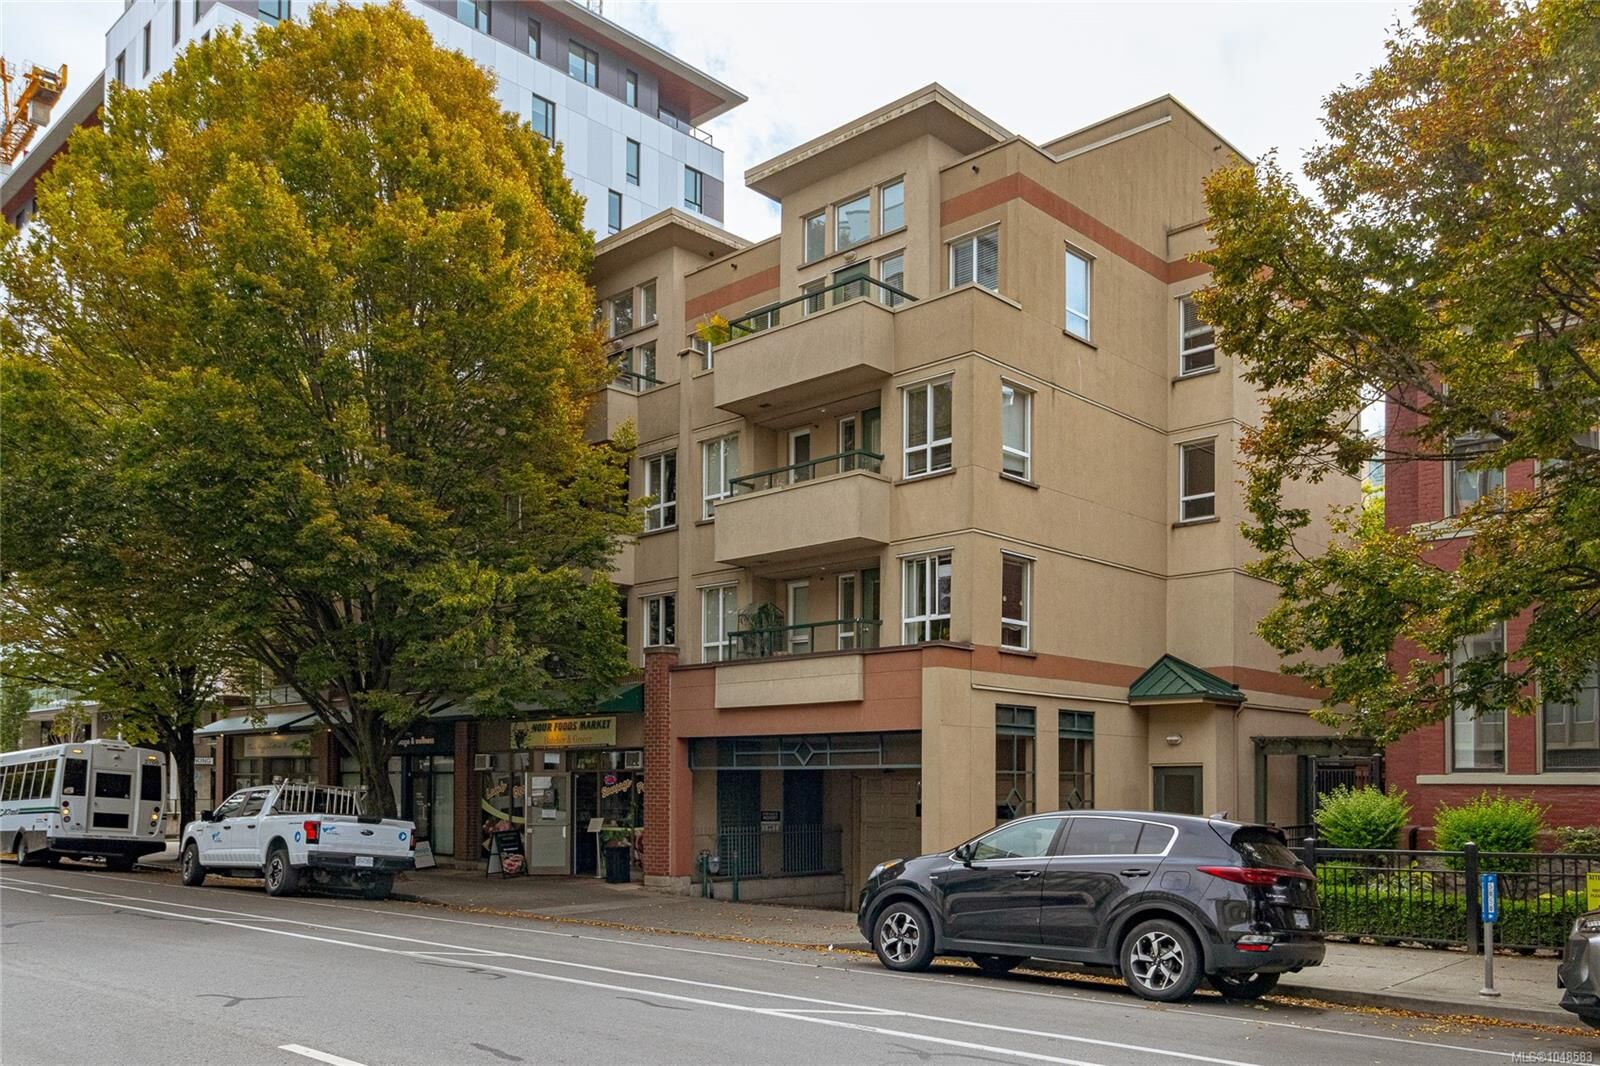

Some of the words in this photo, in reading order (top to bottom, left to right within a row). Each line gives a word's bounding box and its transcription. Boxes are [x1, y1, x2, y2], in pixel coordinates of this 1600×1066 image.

[532, 722, 553, 732] NOUR
[554, 721, 577, 732] FOODS
[579, 719, 611, 731] MARKET
